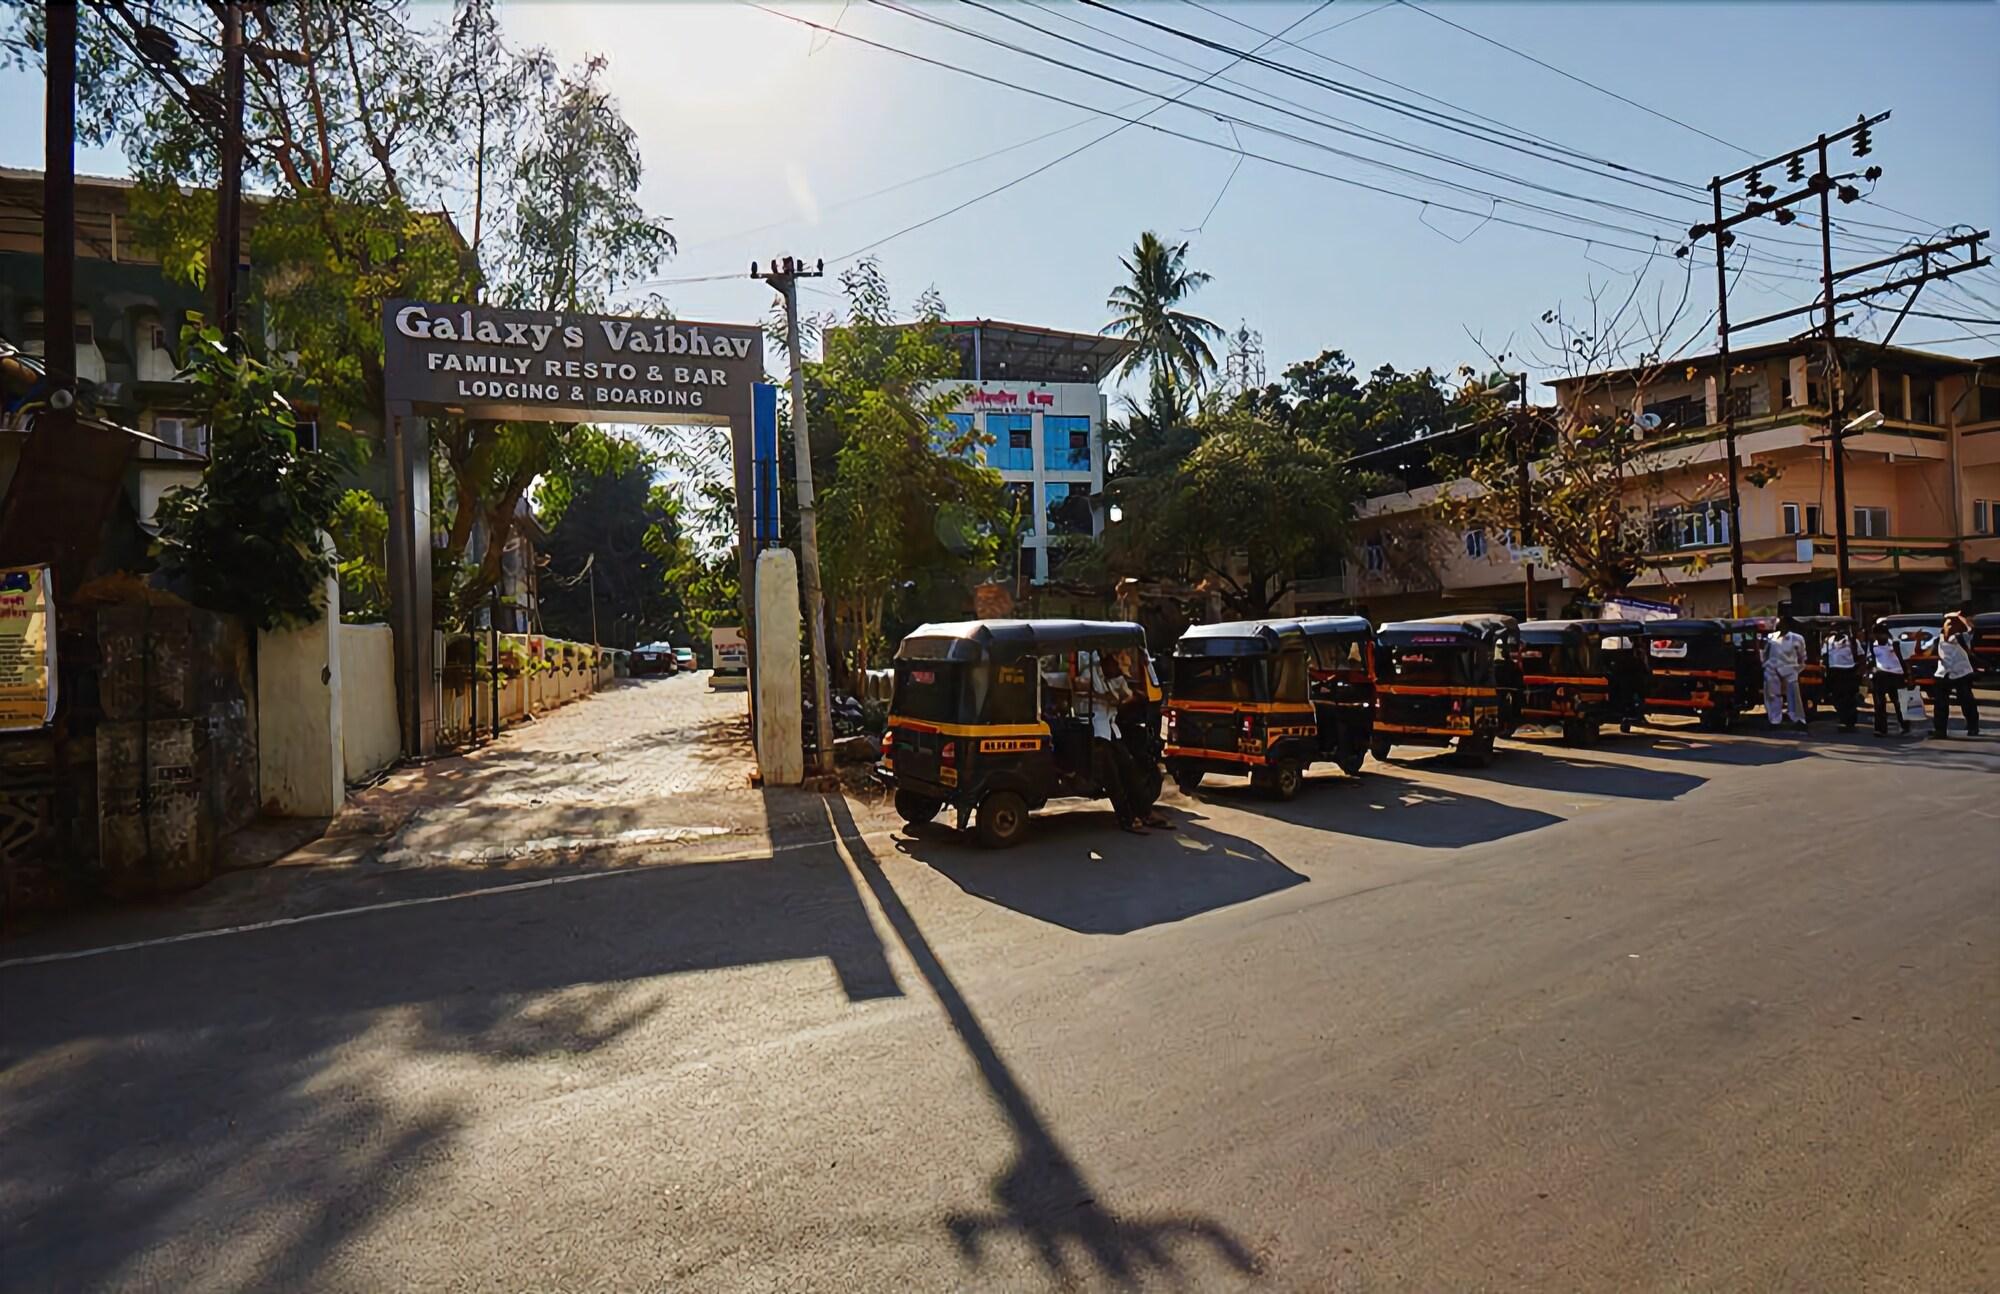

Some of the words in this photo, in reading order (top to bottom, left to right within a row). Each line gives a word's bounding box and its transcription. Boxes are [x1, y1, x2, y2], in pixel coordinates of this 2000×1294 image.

[395, 306, 584, 352] Galaxy's
[599, 320, 752, 358] Vaibhav
[428, 353, 531, 377] FAMILY
[545, 361, 636, 381] RESTO
[647, 365, 663, 382] &
[674, 367, 727, 386] BAR
[458, 380, 559, 400] LODGING
[570, 385, 585, 401] &
[596, 387, 703, 407] BOARDING
